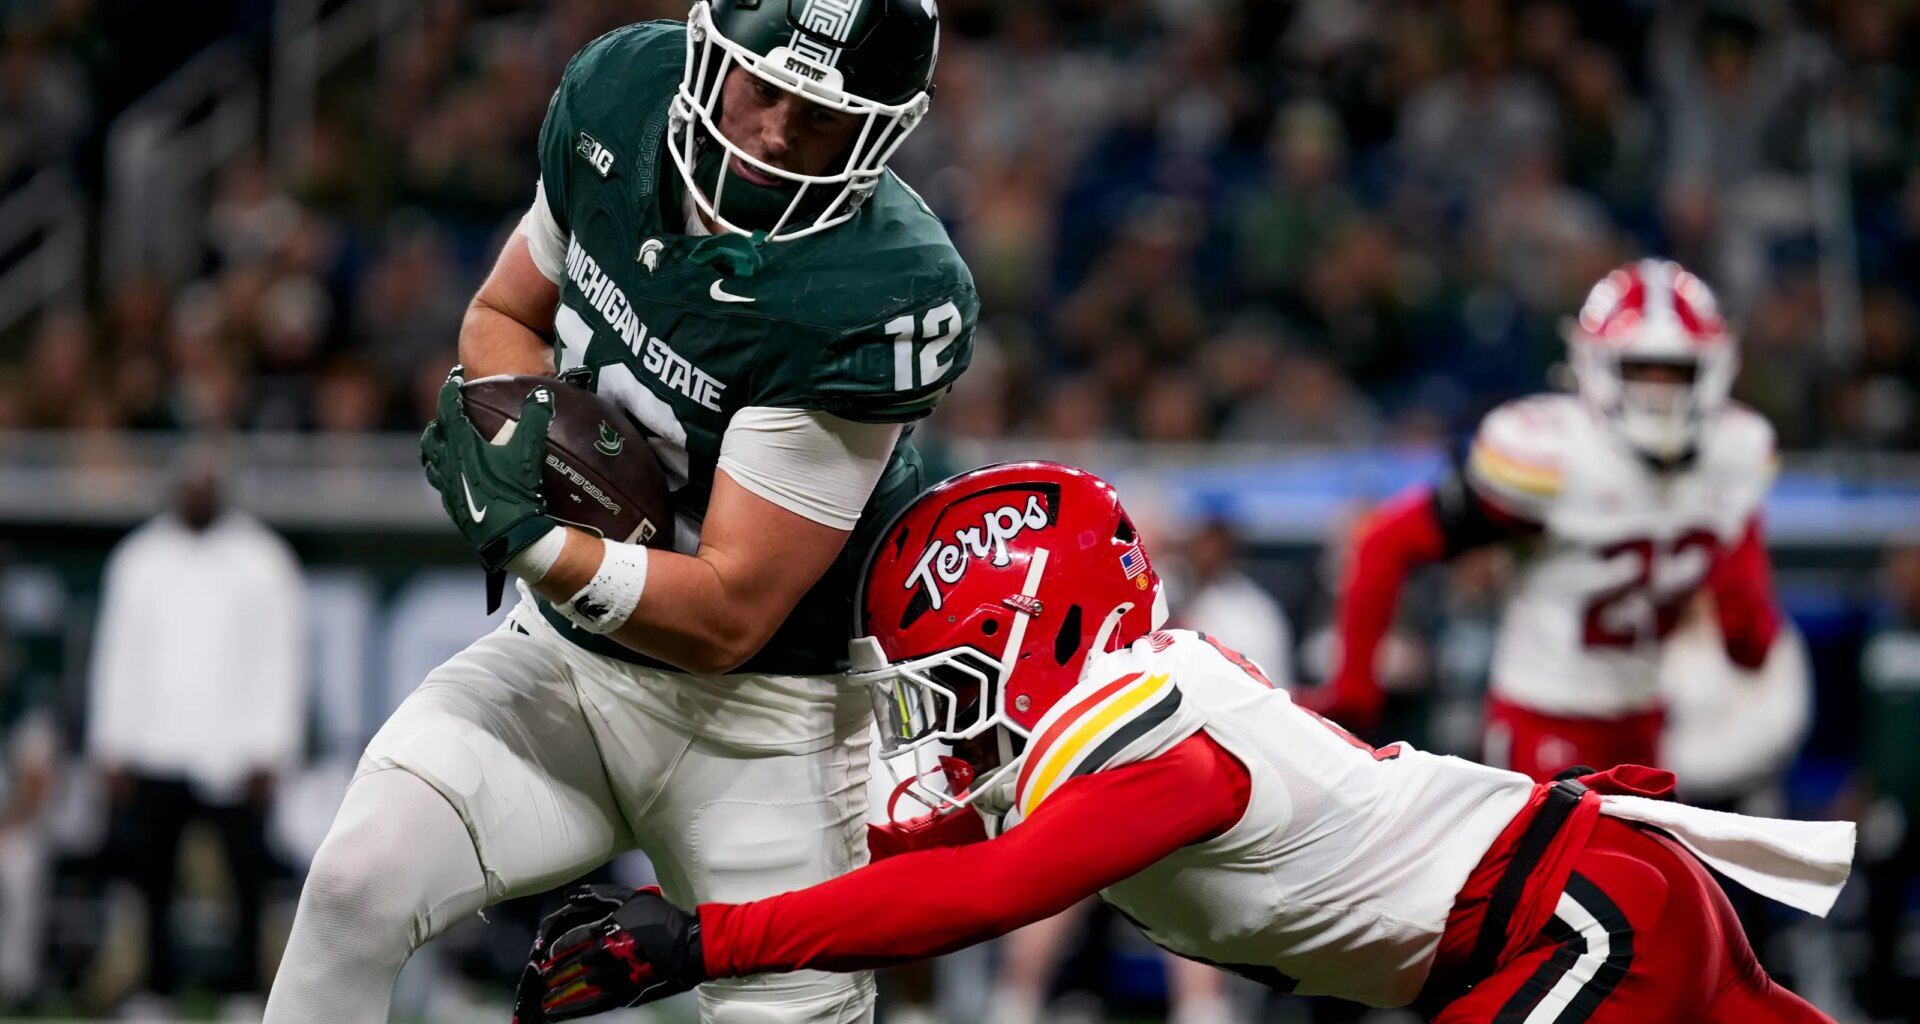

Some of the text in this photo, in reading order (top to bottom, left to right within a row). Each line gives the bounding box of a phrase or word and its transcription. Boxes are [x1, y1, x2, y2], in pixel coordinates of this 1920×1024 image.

[784, 56, 828, 82] STATE
[565, 230, 727, 413] MICHIGAN STATE
[884, 301, 962, 391] 12
[545, 454, 621, 515] VAPOR ELITE
[904, 495, 1048, 611] Terps
